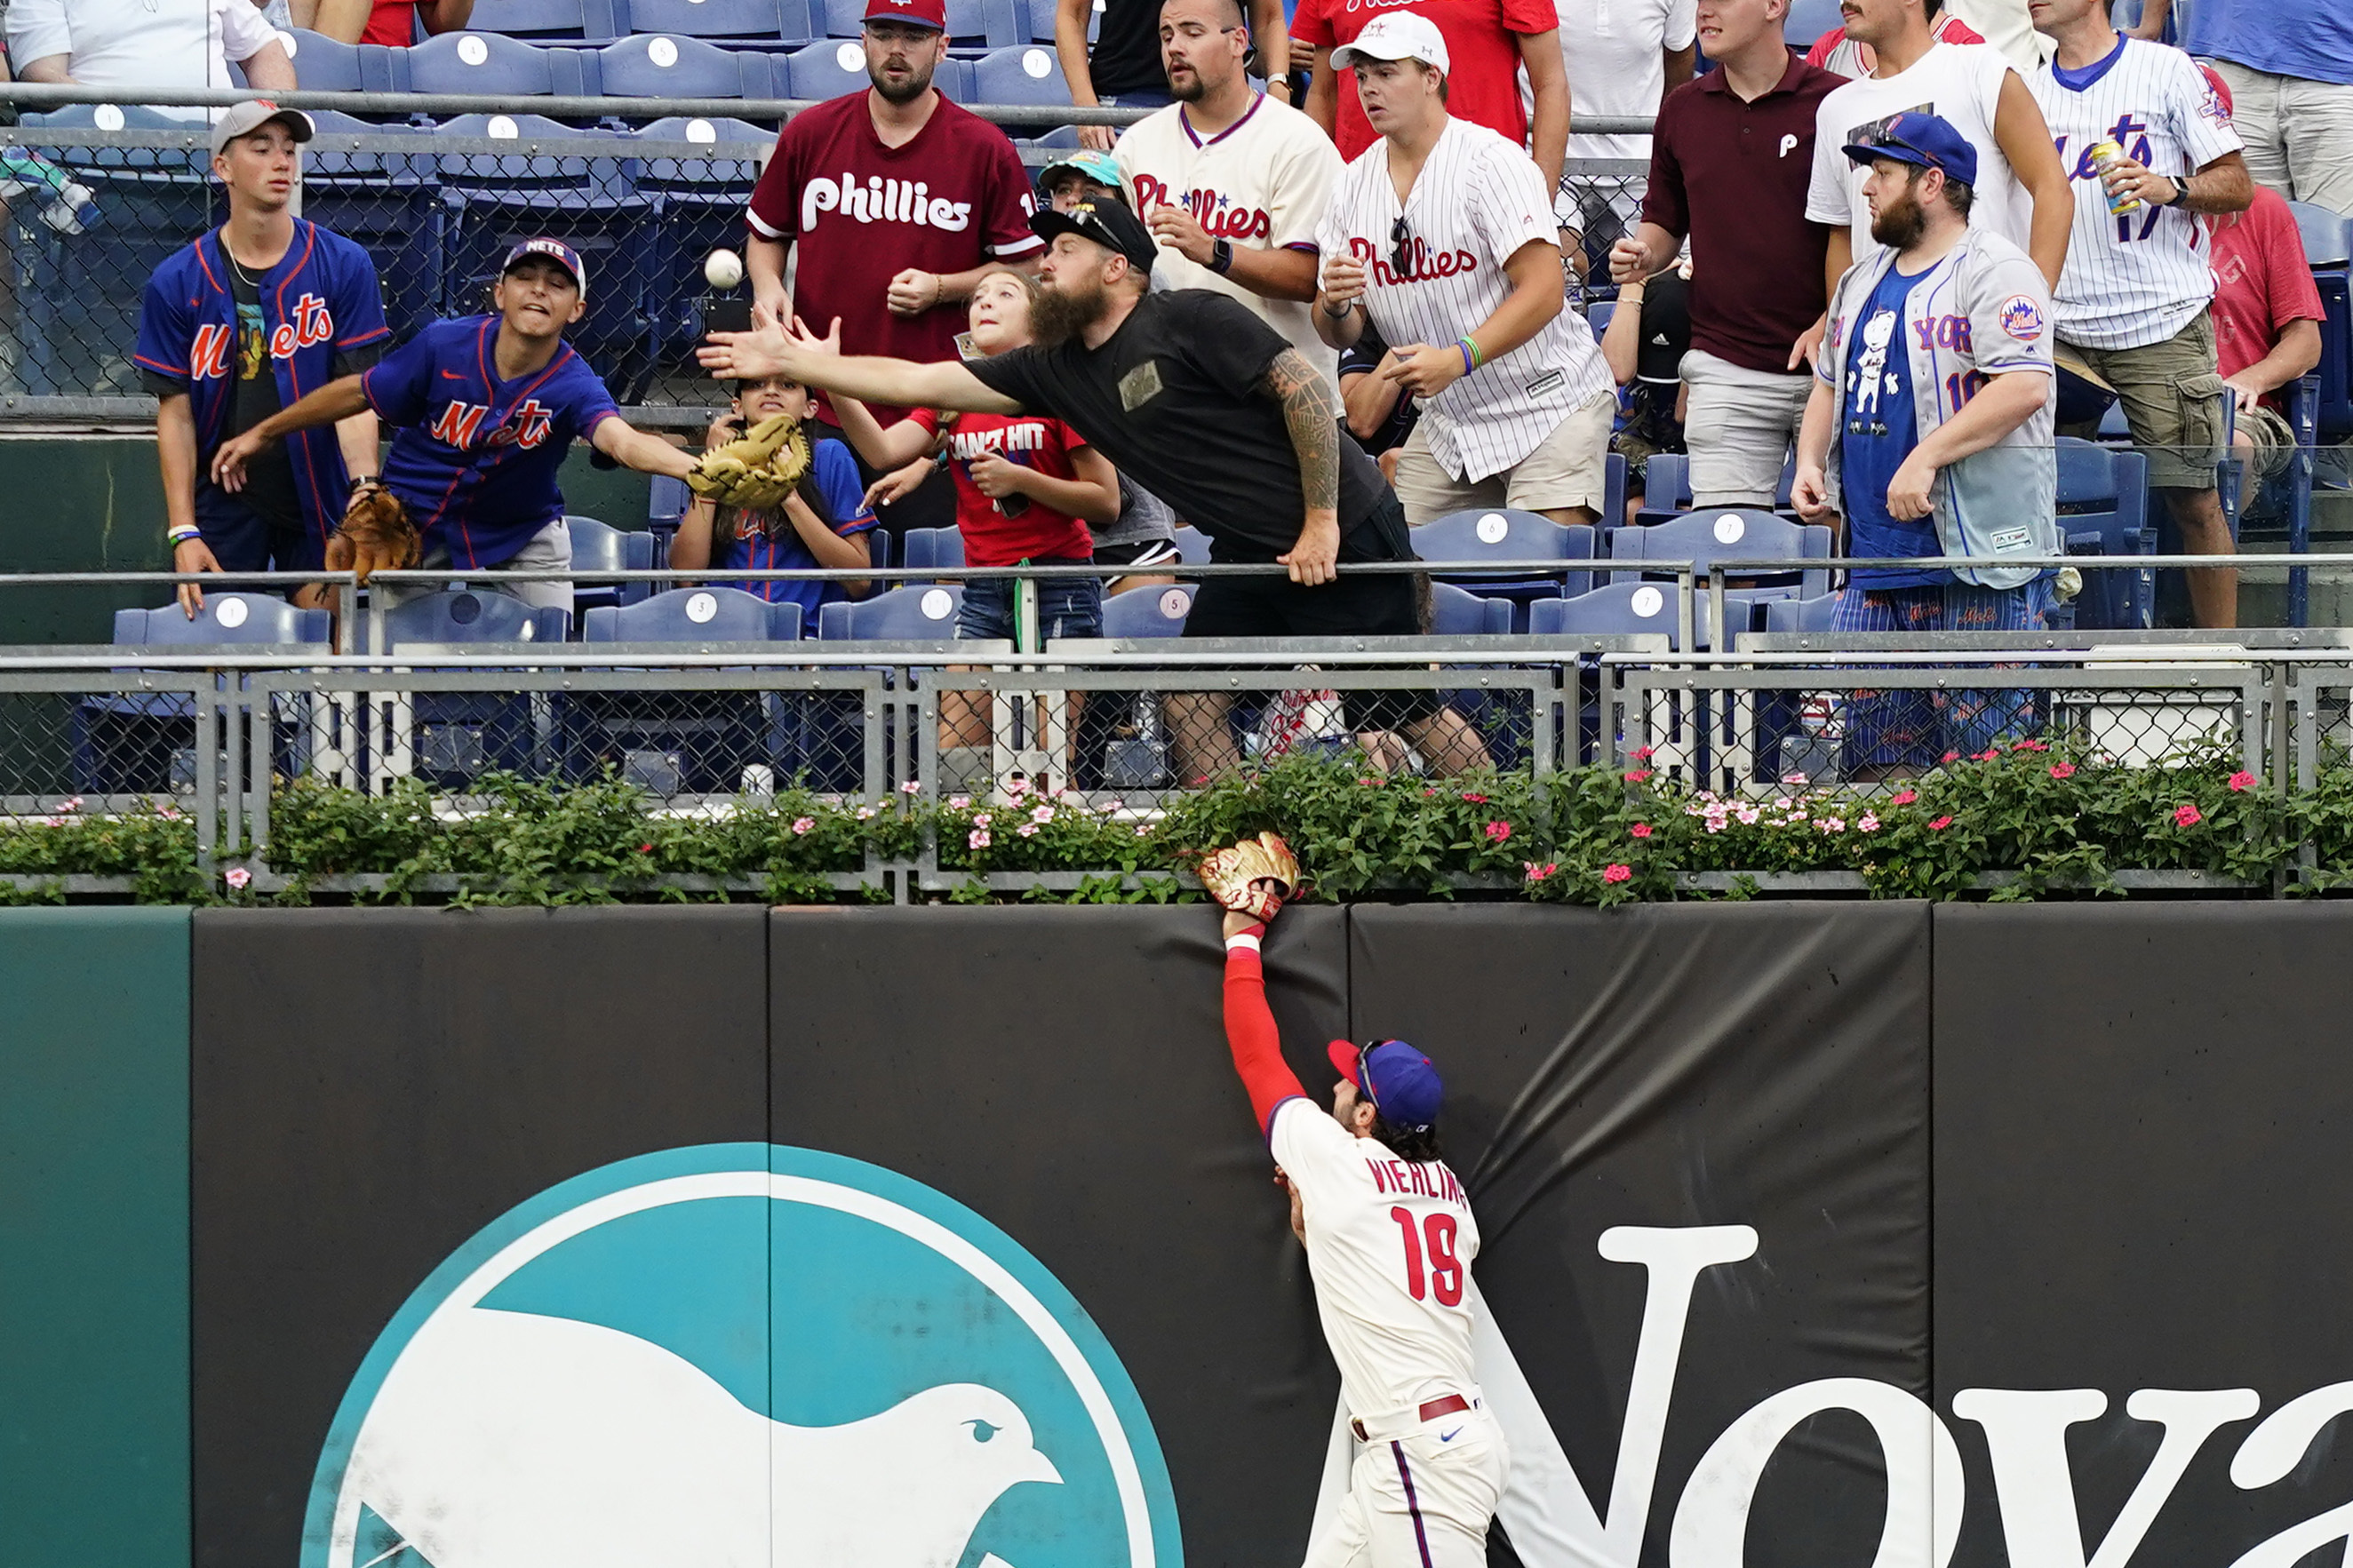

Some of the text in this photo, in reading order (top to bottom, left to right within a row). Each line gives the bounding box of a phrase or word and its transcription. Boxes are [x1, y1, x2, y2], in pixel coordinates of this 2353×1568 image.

[2054, 114, 2153, 182] ets
[430, 399, 554, 451] Mets
[1007, 422, 1046, 451] HIT
[1489, 521, 1496, 533] 6
[1727, 523, 1734, 535] 7
[698, 601, 706, 614] 3
[1170, 598, 1179, 611] 5
[1643, 596, 1651, 609] 7
[1391, 1206, 1464, 1308] 19
